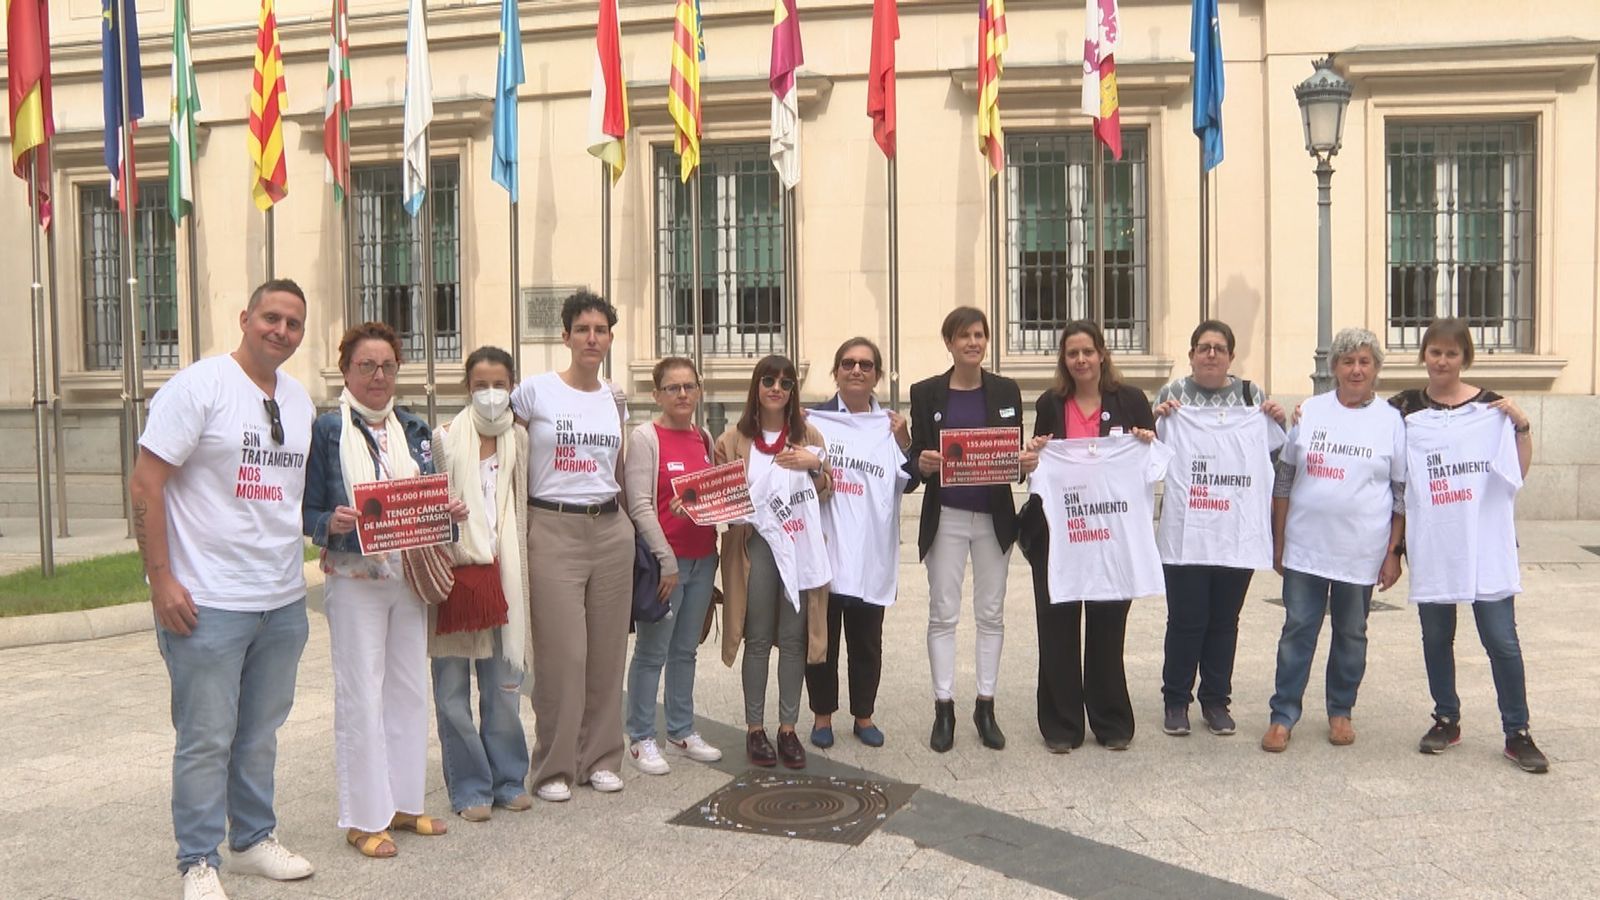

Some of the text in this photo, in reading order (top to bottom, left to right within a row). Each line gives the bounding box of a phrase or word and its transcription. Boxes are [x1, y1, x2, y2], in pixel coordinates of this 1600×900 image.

[555, 419, 573, 431] SIN
[243, 431, 261, 448] SIN
[555, 432, 621, 449] TRATAMIENTO
[1312, 430, 1327, 441] SIN
[829, 443, 845, 455] SIN
[966, 438, 1019, 448] 155.000 FIRMAS
[555, 446, 576, 458] NOS
[966, 450, 1019, 461] TENGO CÁNCER
[1309, 441, 1373, 460] TRATAMIENTO
[241, 448, 305, 469] TRATAMIENTO
[554, 459, 598, 472] MORIMOS
[956, 460, 977, 468] MAMA
[1306, 452, 1325, 465] NOS
[1426, 453, 1442, 467] SIN
[238, 465, 261, 482] NOS
[828, 455, 885, 478] TRATAMIENTO
[1191, 460, 1207, 473] SIN
[1306, 464, 1346, 480] MORIMOS
[831, 468, 843, 480] OS
[1191, 473, 1252, 488] TRATAMIENTO
[236, 482, 284, 502] MORIMOS
[1190, 485, 1208, 498] NOS
[1429, 479, 1449, 492] NOS
[386, 487, 449, 503] 155.000 FIRMAS
[699, 490, 722, 503] TENGO
[1063, 492, 1080, 506] SIN
[1431, 488, 1473, 506] MORIMOS
[770, 496, 784, 513] SIN
[1065, 501, 1128, 519] TRATAMIENTO
[1189, 498, 1230, 511] MORIMOS
[386, 507, 415, 519] TENGO
[363, 511, 450, 531] DE MAMA METASTÁSICO
[1067, 517, 1087, 531] NOS
[373, 531, 405, 542] FINANCIEN
[405, 529, 414, 537] LA
[1069, 528, 1110, 543] MORIMOS
[366, 542, 380, 551] QUE
[379, 537, 420, 549] NECESITAMOS
[420, 535, 436, 543] PARA
